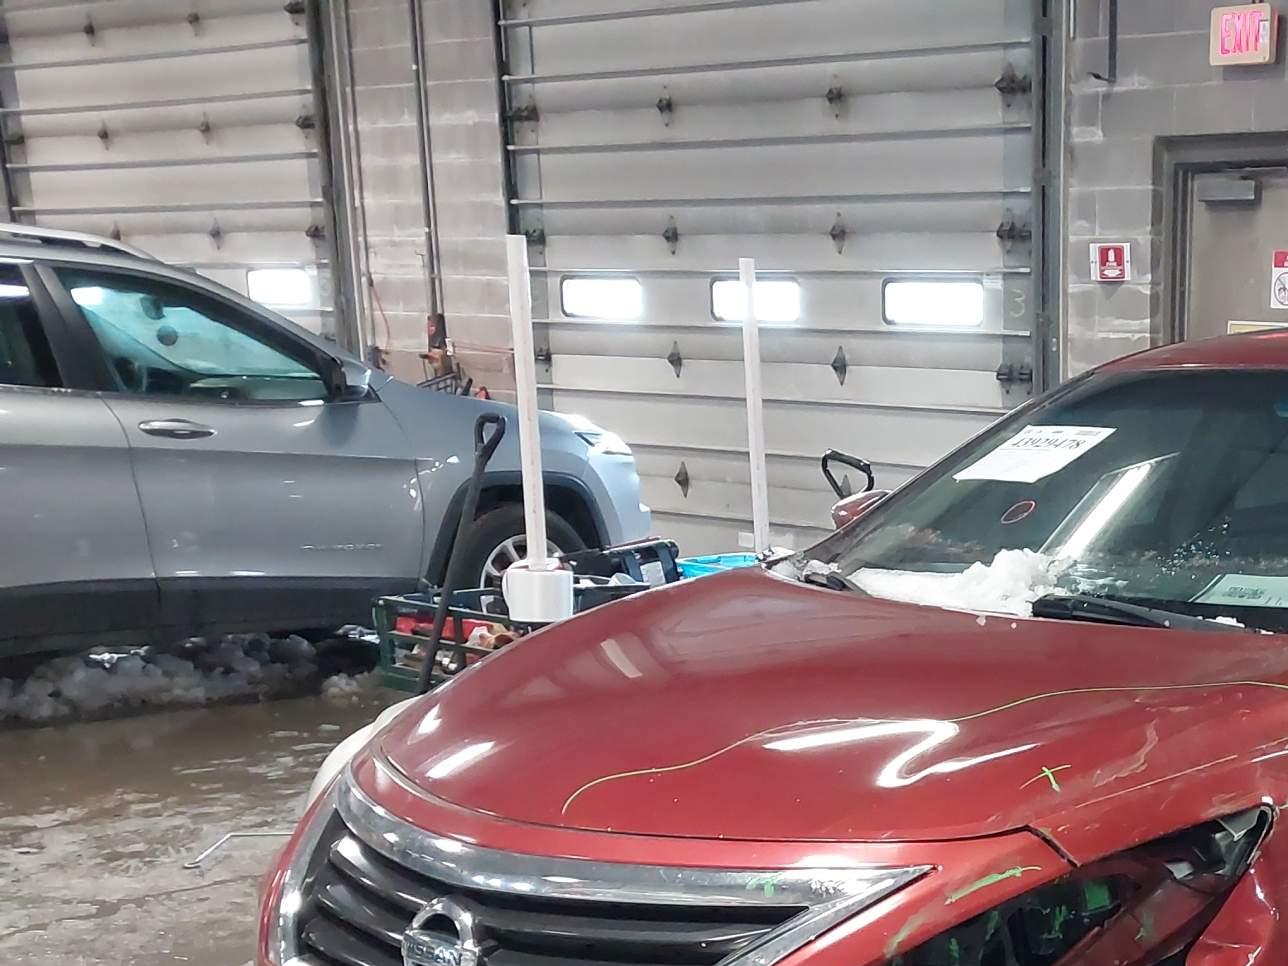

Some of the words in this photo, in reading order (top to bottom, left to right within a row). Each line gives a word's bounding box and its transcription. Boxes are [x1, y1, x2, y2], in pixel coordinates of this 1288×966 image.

[1220, 10, 1263, 56] EXIT
[1009, 288, 1026, 318] 3
[1011, 437, 1088, 450] 43929478
